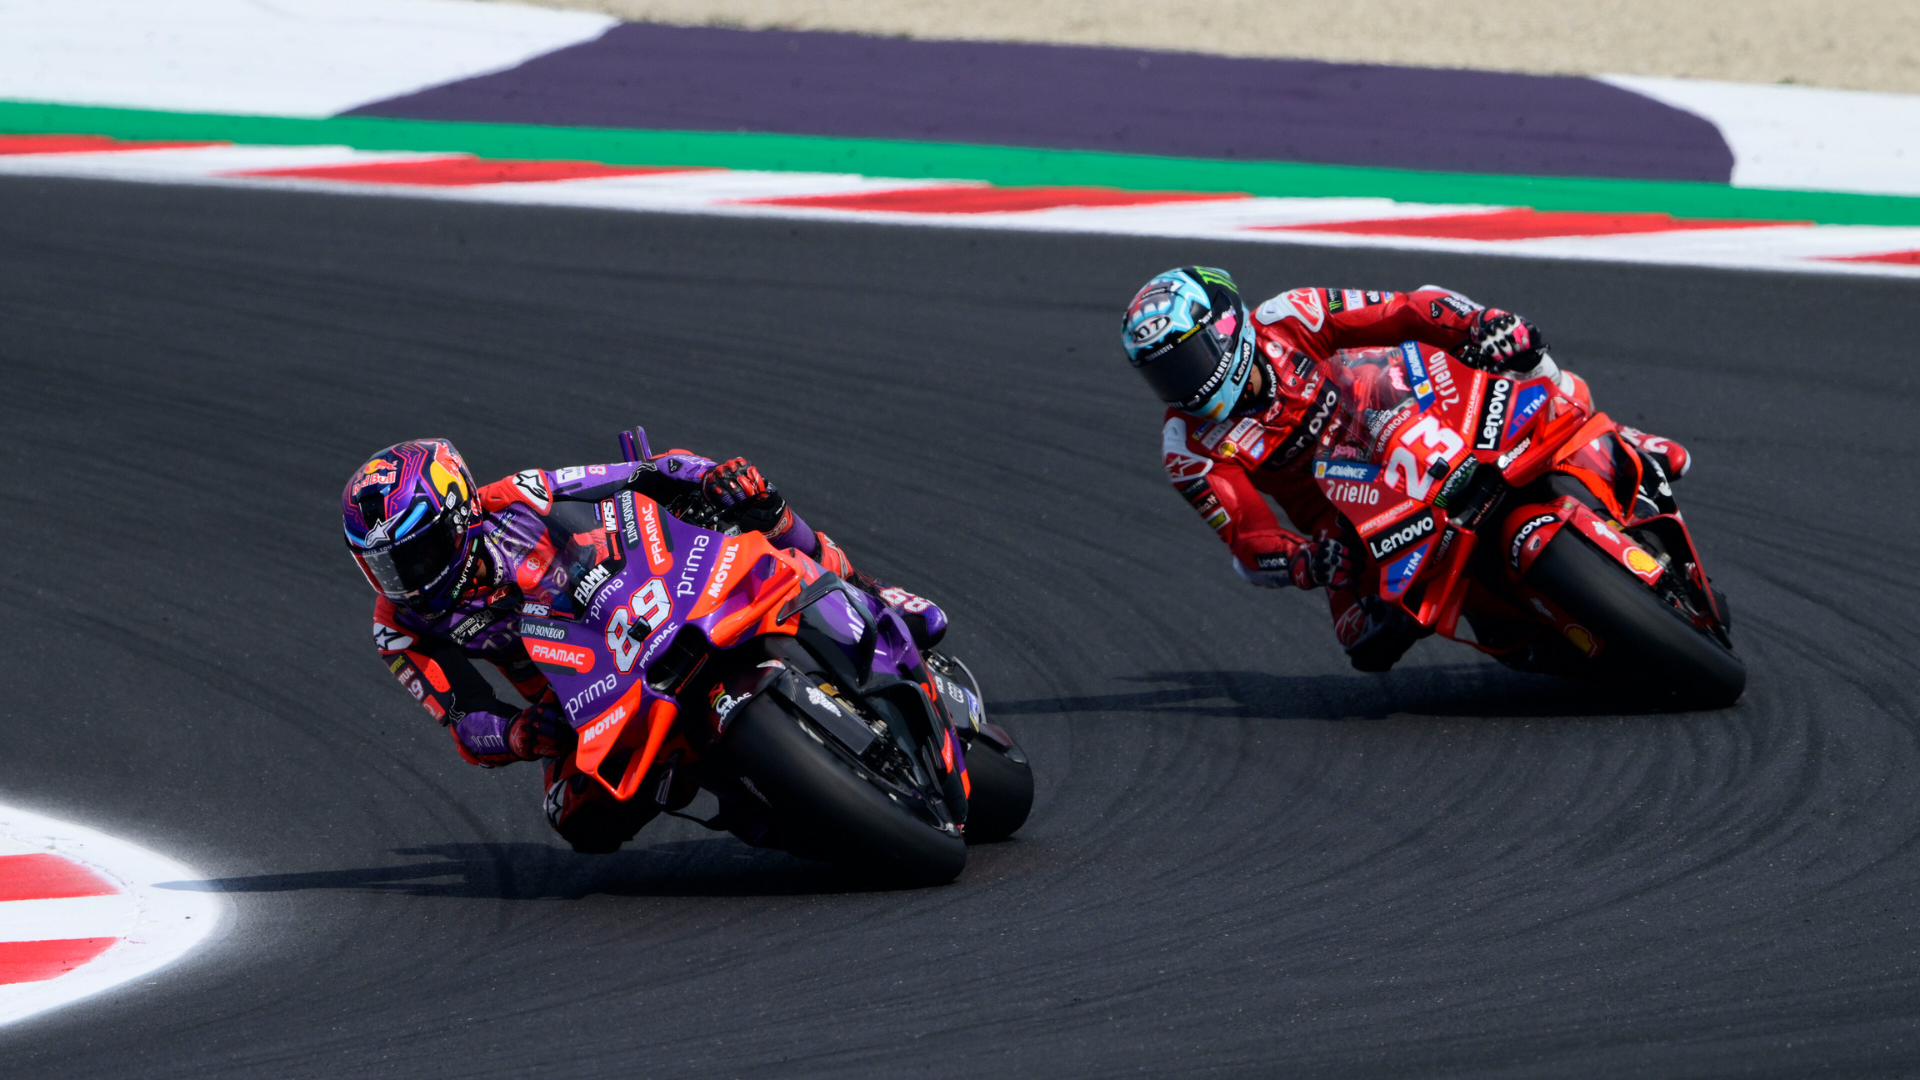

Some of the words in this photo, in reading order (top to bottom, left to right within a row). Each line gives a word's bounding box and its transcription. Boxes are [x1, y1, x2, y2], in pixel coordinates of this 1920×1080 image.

[1198, 351, 1233, 397] TERRANOVA
[1233, 342, 1250, 382] Lenovo
[1462, 373, 1483, 435] FRECCIAROSSA
[1477, 379, 1510, 451] Lenovo
[1523, 393, 1548, 416] TIM
[1376, 410, 1412, 453] VARGROUP
[370, 471, 396, 485] Bull
[1384, 414, 1466, 502] 23
[1441, 456, 1477, 496] MONSTER
[604, 502, 618, 531] WRS
[641, 503, 666, 565] PRAMAC
[1369, 516, 1434, 559] Lenovo
[1512, 514, 1554, 568] Lenovo
[574, 564, 610, 606] FIAMM
[677, 535, 710, 598] prima
[708, 543, 739, 598] MOTUL
[1403, 551, 1423, 577] TIM
[522, 604, 550, 616] WRS
[590, 578, 624, 620] prima
[521, 624, 537, 638] LINO
[536, 625, 565, 640] SONEGO
[606, 578, 674, 673] 89
[640, 622, 678, 669] PRAMAC
[532, 645, 585, 666] PRAMAC
[565, 673, 617, 721] prima
[584, 705, 627, 743] MOTUL
